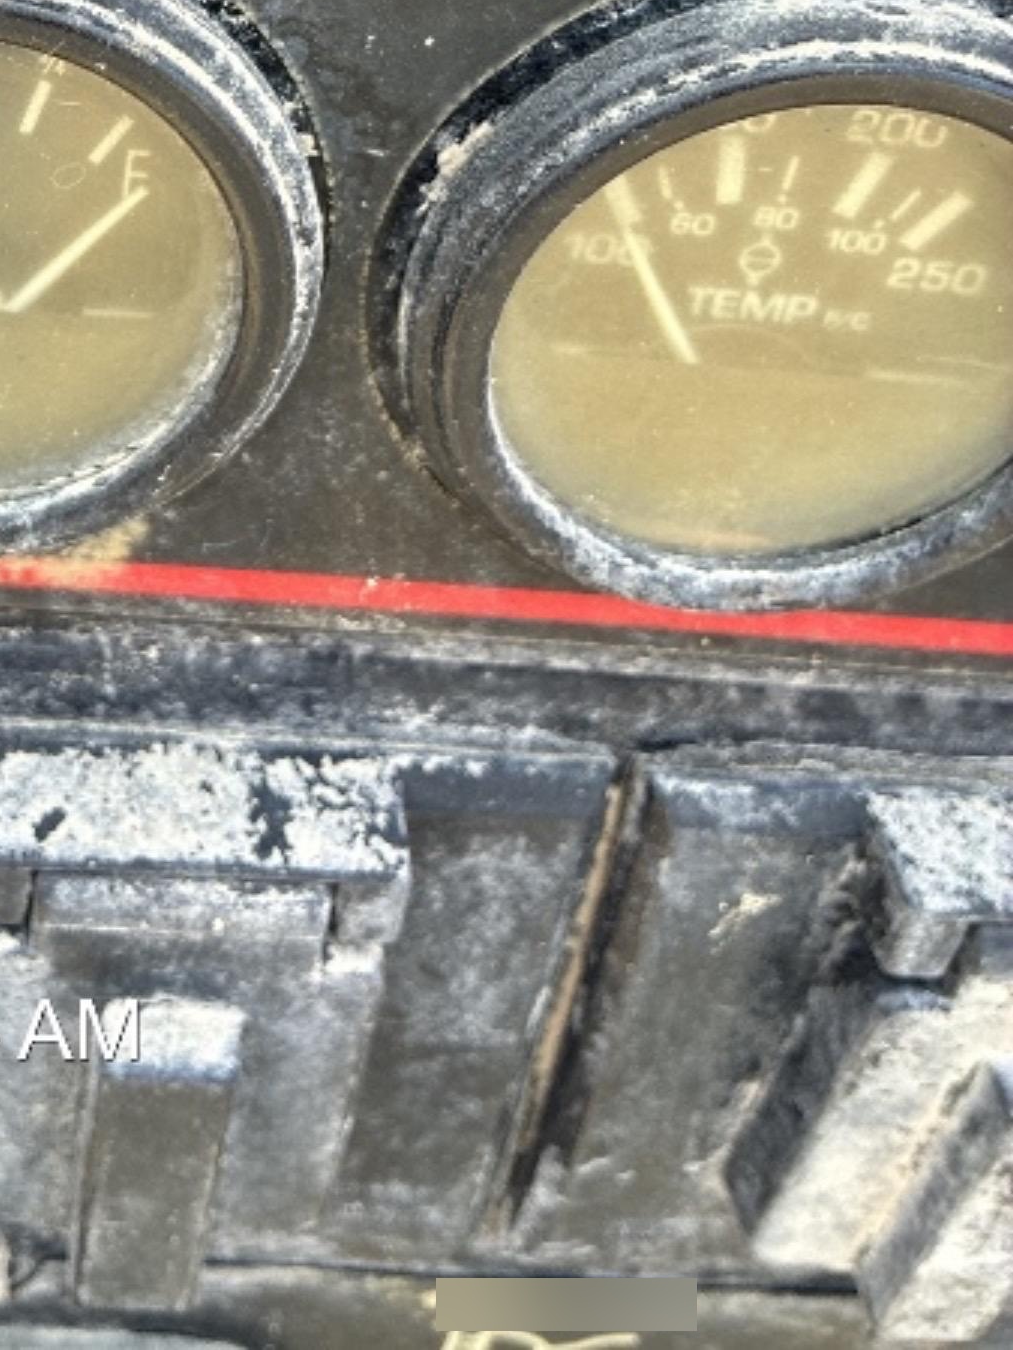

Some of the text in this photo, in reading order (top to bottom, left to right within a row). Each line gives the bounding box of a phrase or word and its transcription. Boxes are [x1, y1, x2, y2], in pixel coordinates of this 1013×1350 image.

[846, 110, 949, 148] 200
[122, 149, 151, 196] F
[670, 211, 716, 237] 60
[753, 205, 800, 230] 80
[826, 227, 888, 256] 100
[886, 256, 986, 295] 250
[688, 285, 820, 325] TEMP
